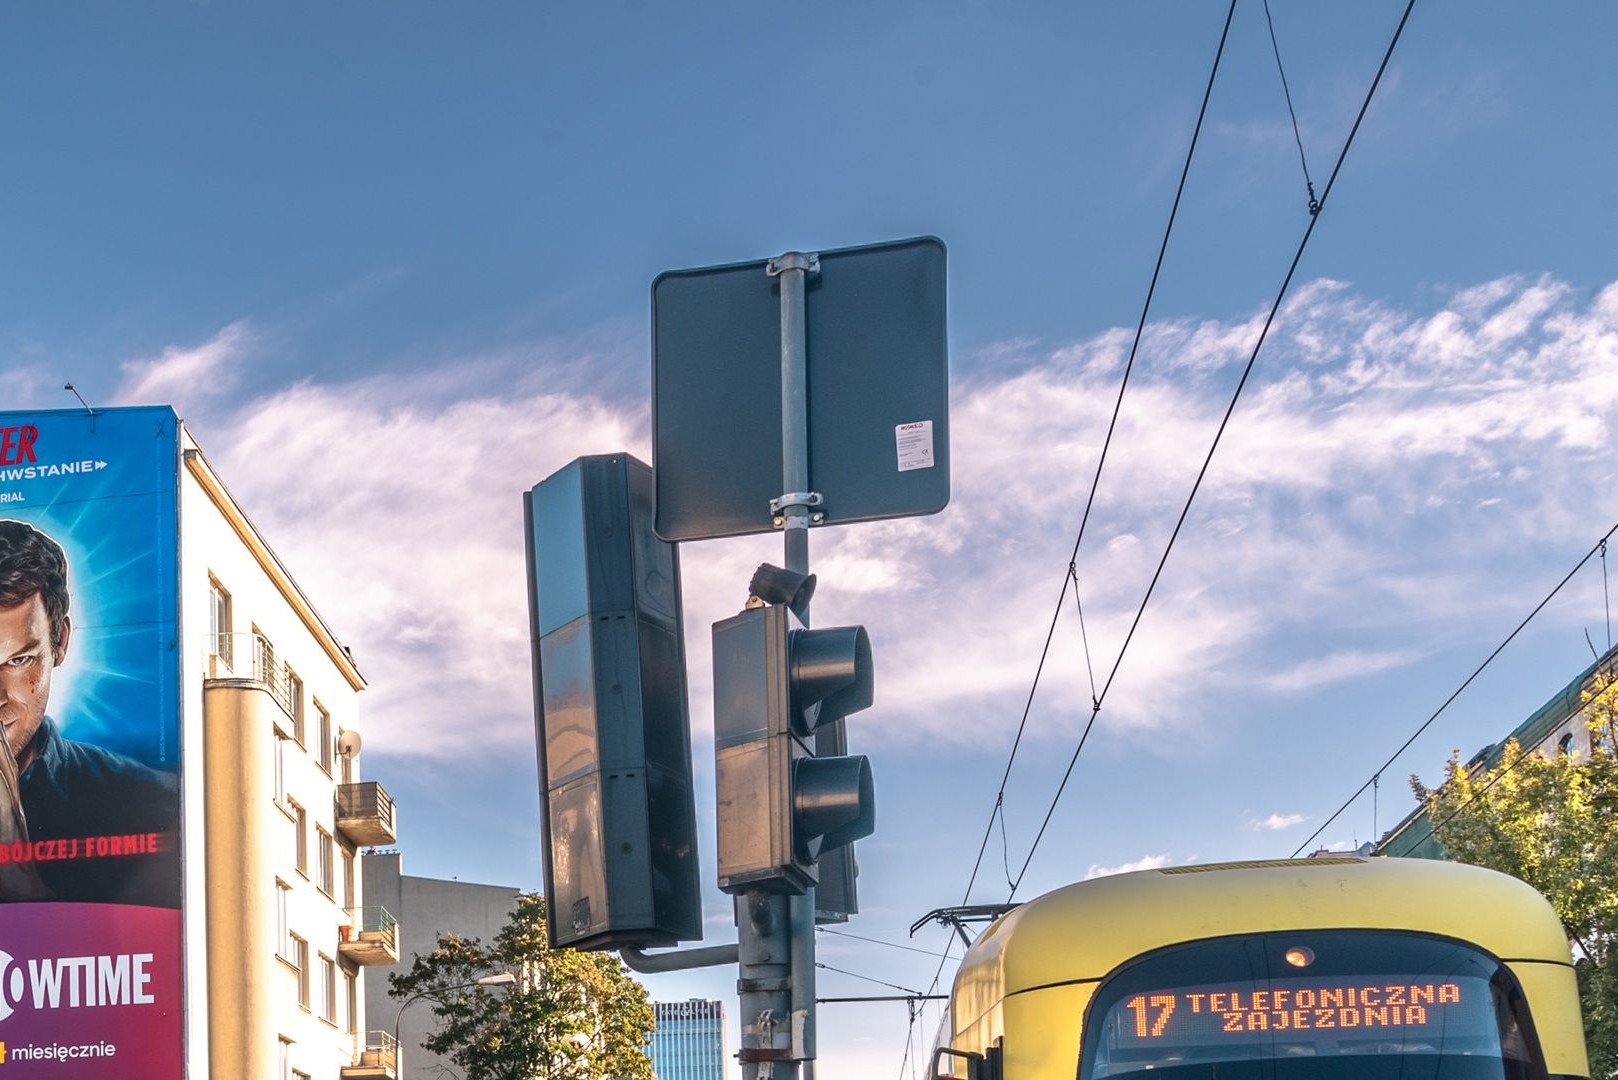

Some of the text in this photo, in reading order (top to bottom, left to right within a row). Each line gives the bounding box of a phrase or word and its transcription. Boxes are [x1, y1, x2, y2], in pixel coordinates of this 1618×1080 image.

[85, 833, 157, 858] FORMIE
[1127, 983, 1460, 1037] 17 TELEFONICZNA
[1223, 1005, 1426, 1032] ZAJEZDNIA
[11, 1039, 116, 1062] miesięcznie
